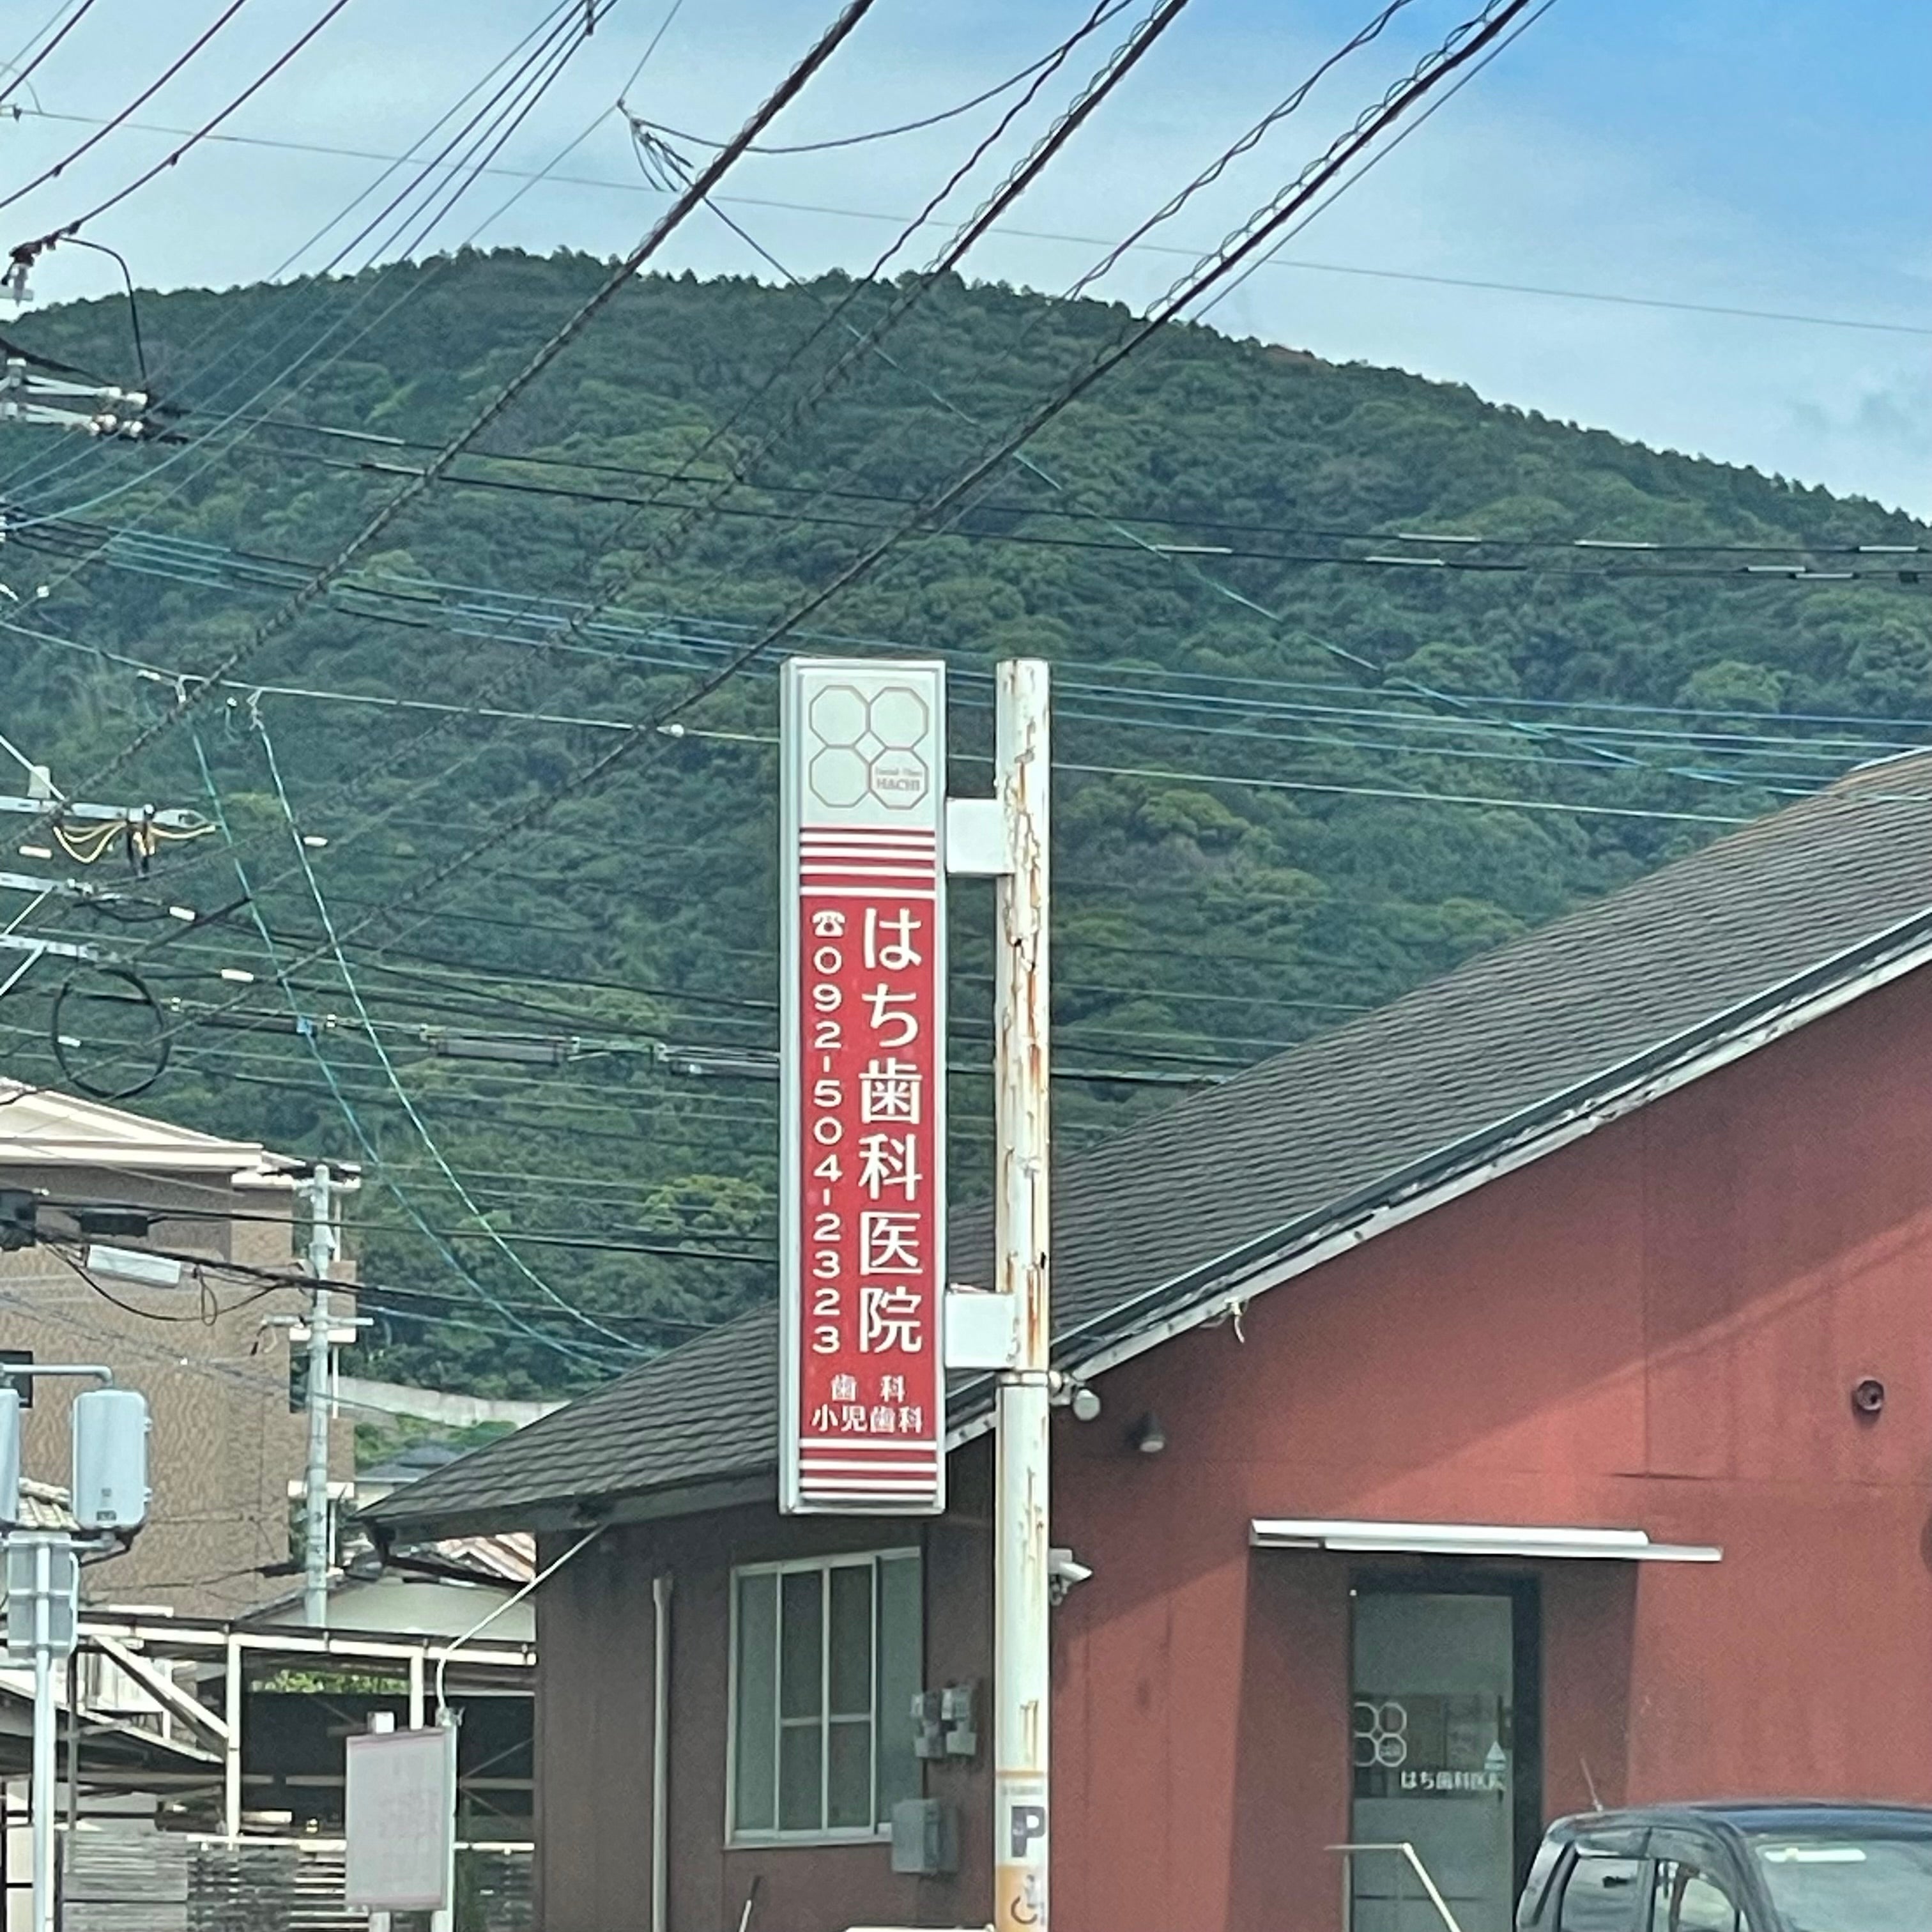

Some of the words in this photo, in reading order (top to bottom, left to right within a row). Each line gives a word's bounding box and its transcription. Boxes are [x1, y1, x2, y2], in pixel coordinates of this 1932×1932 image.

[812, 946, 843, 1354] 092-504-2323
[858, 908, 923, 1353] はち歯科医院
[811, 1404, 922, 1433] 小児歯科
[1011, 1805, 1046, 1857] P
